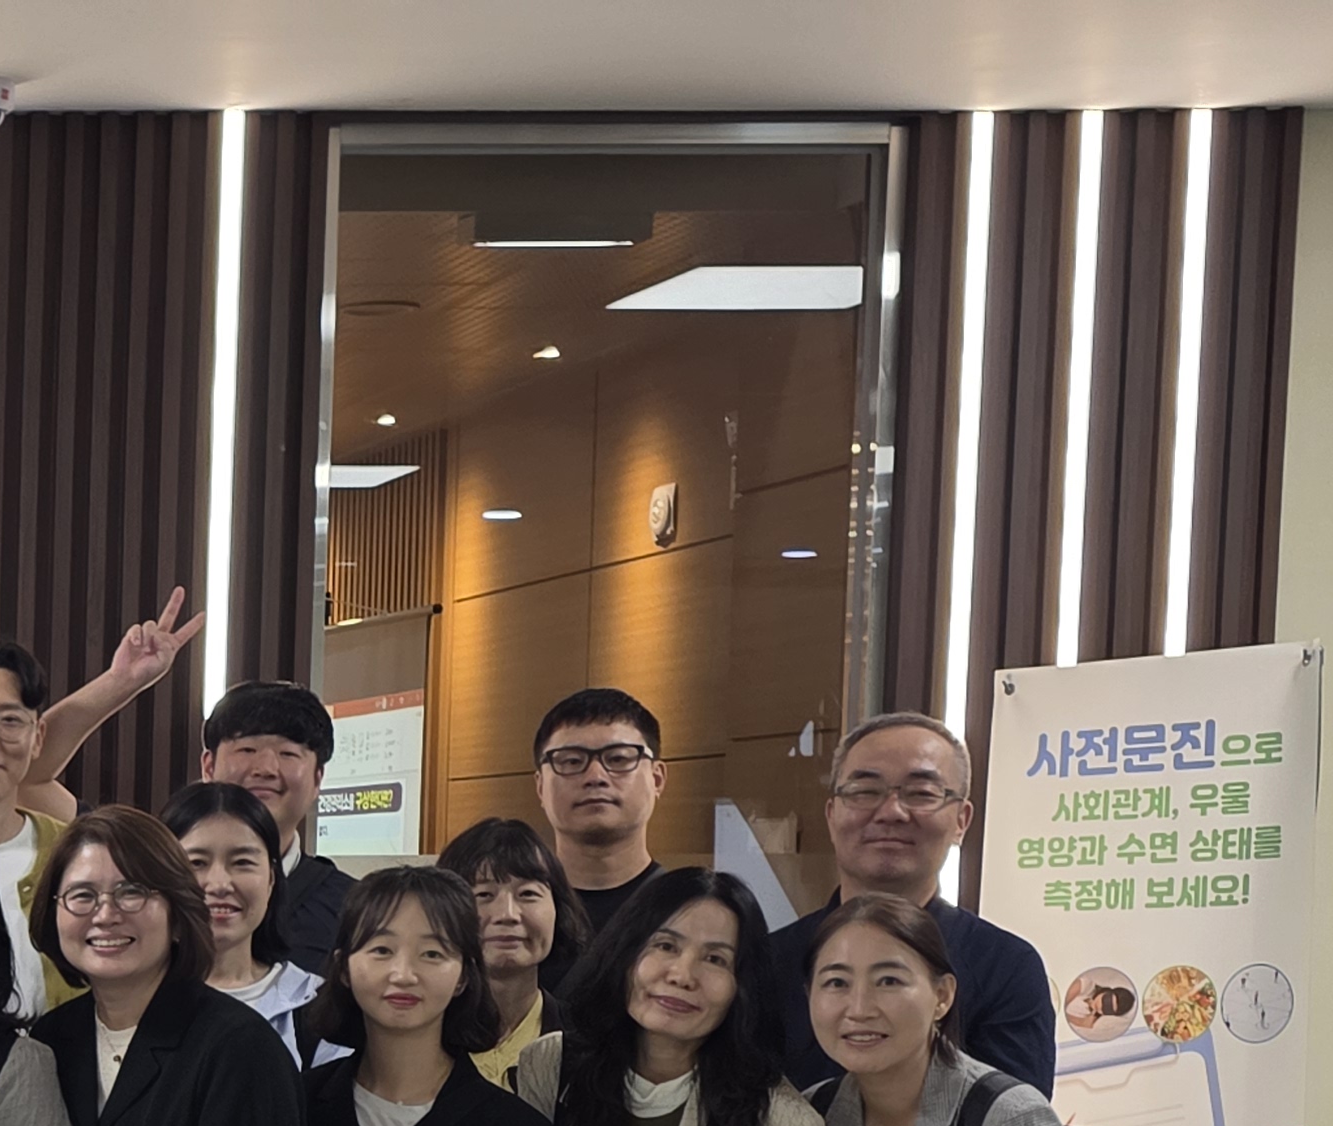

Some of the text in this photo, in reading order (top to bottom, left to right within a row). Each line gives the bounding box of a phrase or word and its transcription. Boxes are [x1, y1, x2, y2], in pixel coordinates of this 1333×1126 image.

[1027, 719, 1282, 778] 사전문진으로
[1051, 781, 1251, 822] 사회관계, 우울
[1017, 825, 1282, 869] 영양과 수면 상태를
[1043, 873, 1251, 911] 측정해 보세요!
